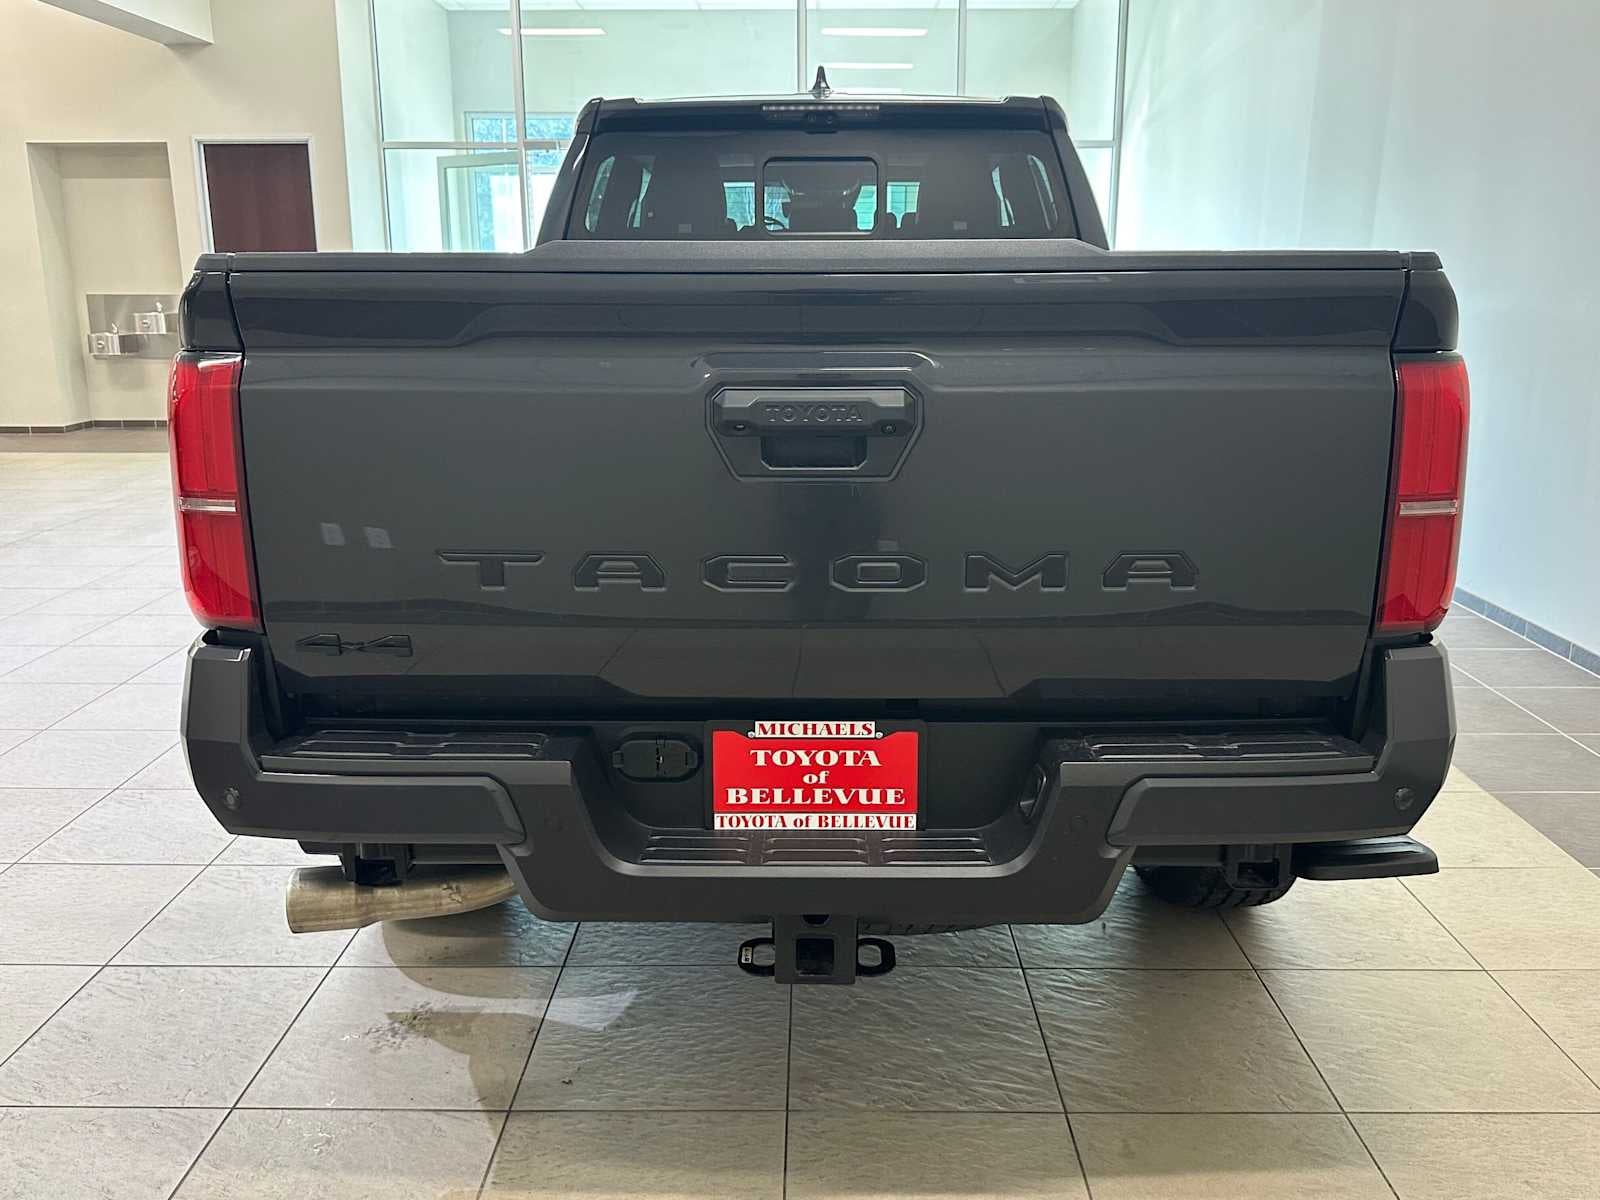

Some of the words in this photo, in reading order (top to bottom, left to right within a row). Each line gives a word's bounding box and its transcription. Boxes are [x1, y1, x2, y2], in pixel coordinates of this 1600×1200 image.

[765, 404, 864, 422] TOYOTA
[436, 550, 1198, 592] TACOMA
[757, 723, 873, 736] MICHAELS
[750, 749, 882, 767] TOYOTA
[802, 770, 830, 785] of
[726, 788, 906, 805] BELLEVUE
[716, 815, 788, 828] TOYOTA
[793, 815, 810, 828] of
[818, 815, 915, 828] BELLEVUE
